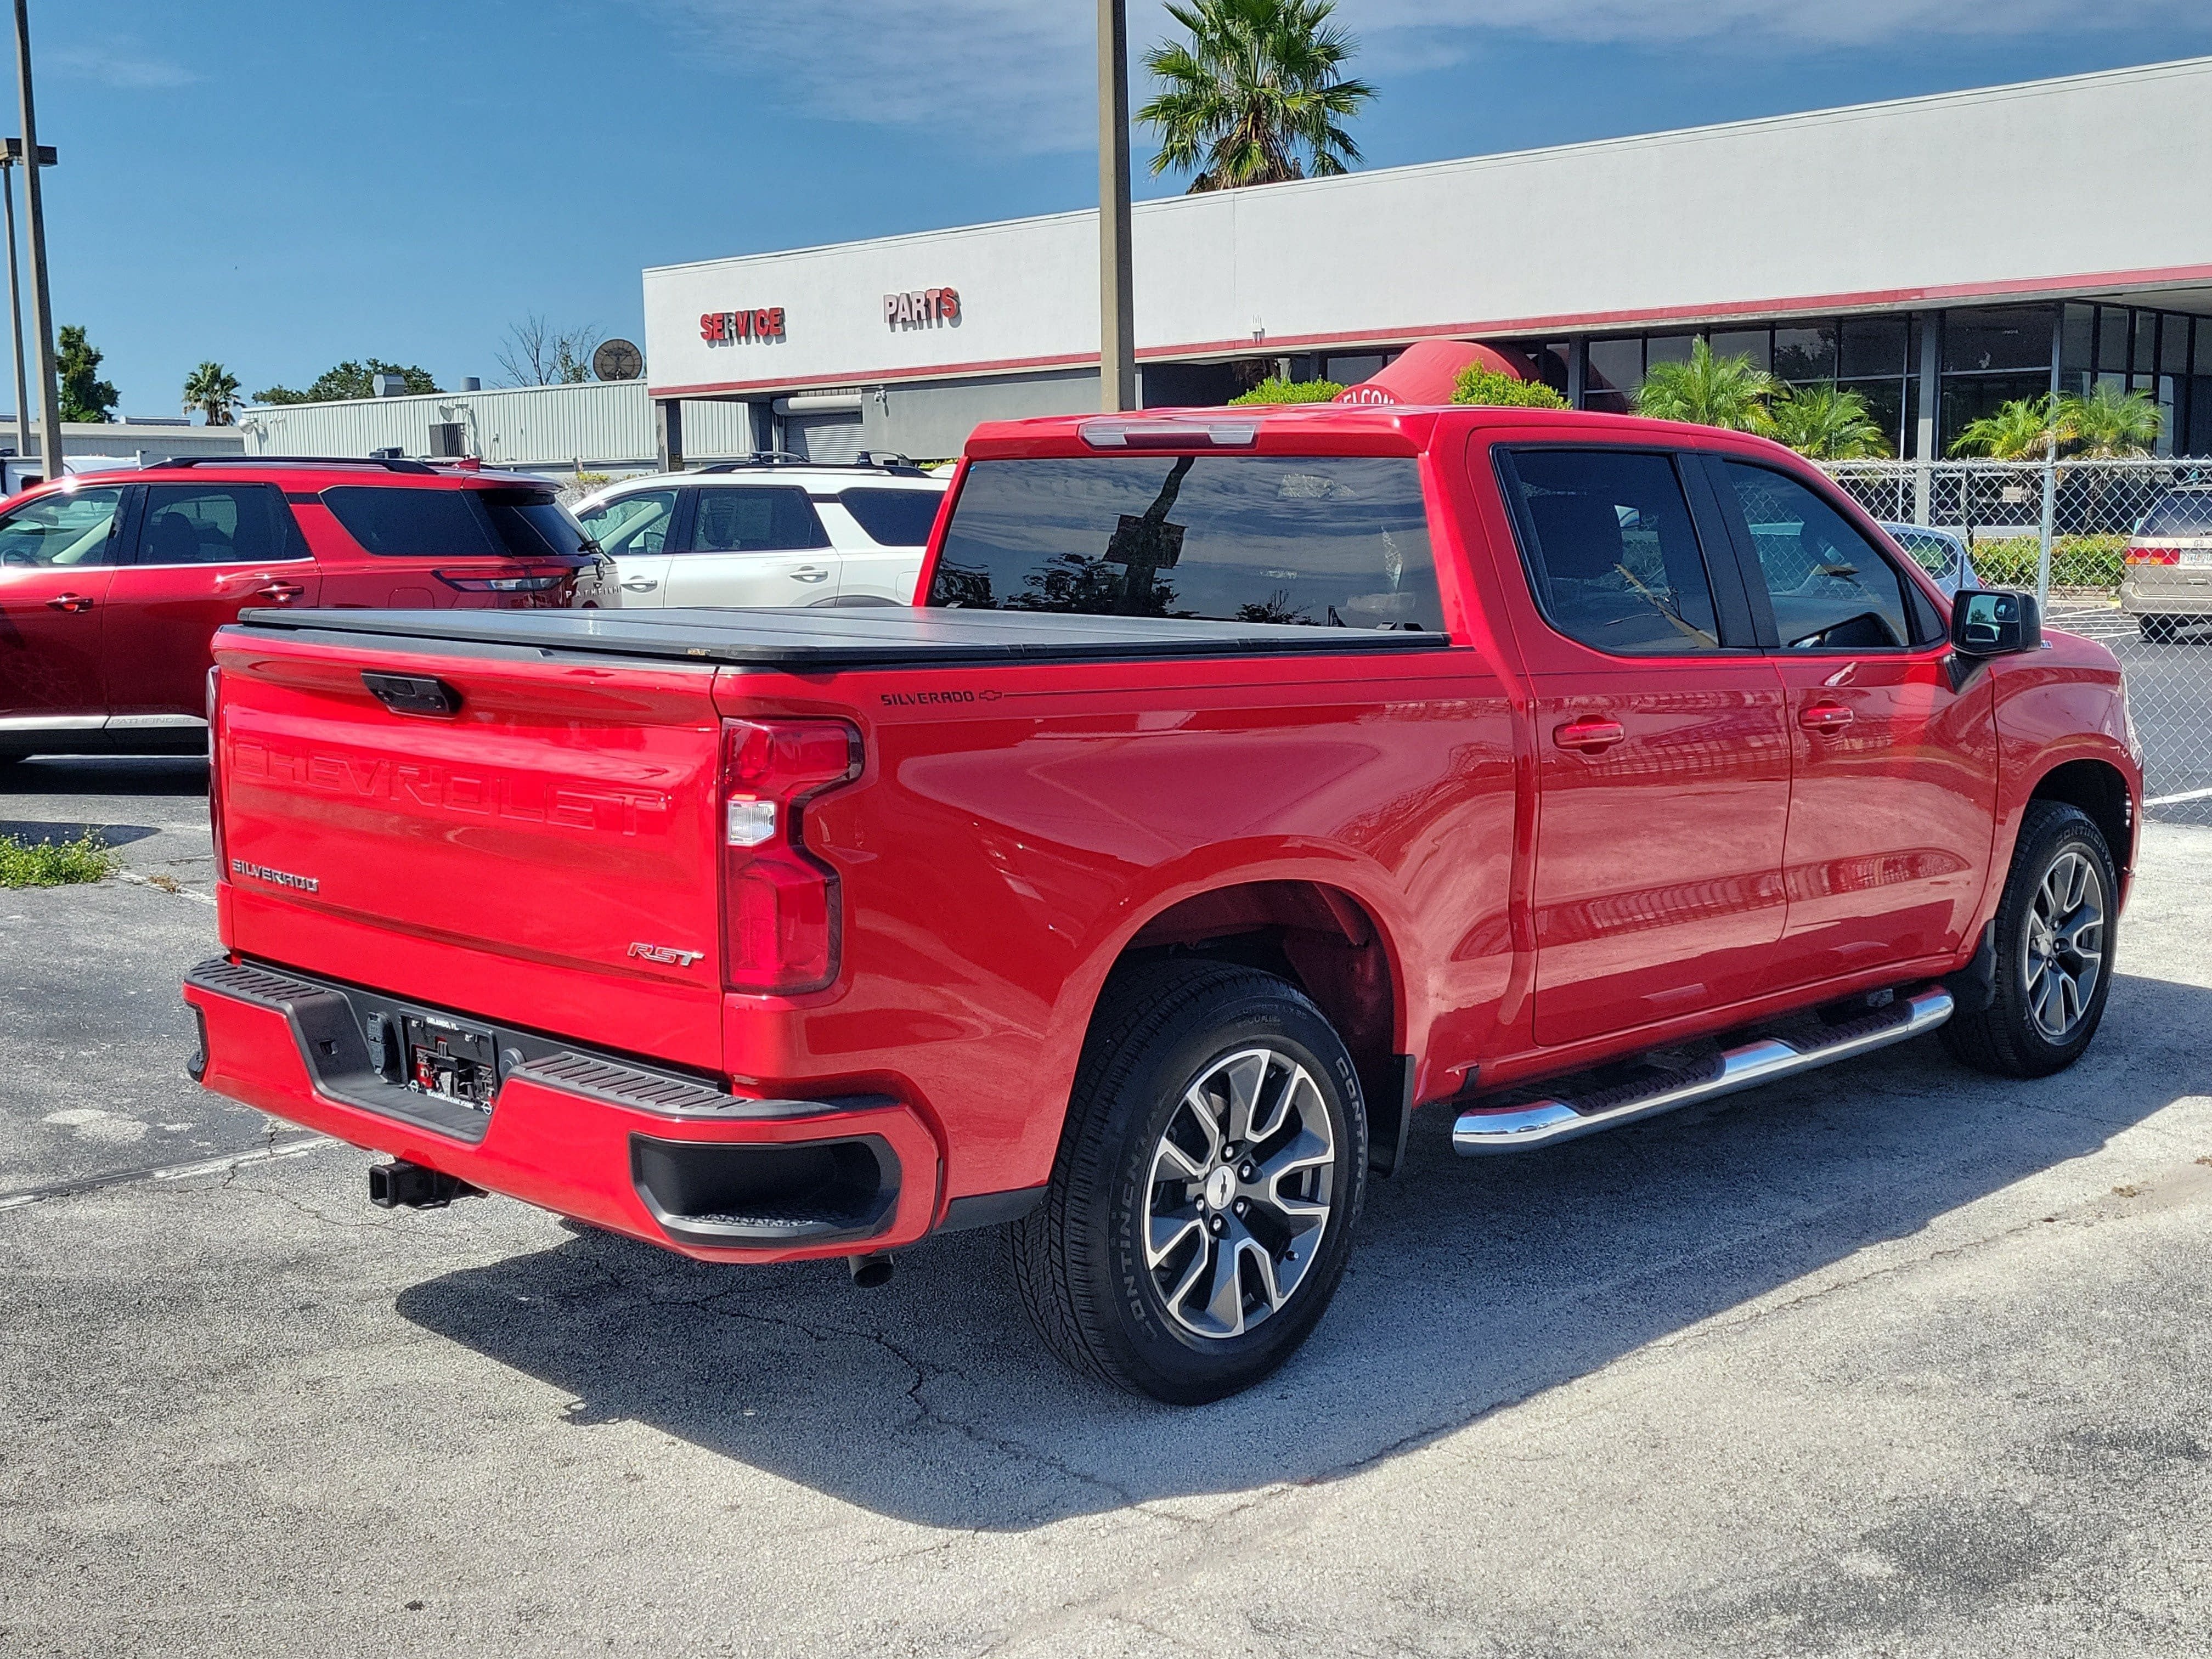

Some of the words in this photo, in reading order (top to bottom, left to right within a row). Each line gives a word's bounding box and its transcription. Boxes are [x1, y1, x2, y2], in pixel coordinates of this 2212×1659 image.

[884, 286, 959, 324] PARTS
[700, 307, 784, 341] SERVICE
[881, 690, 975, 707] SILVERADO
[234, 738, 666, 837] CHEVROLET
[232, 858, 319, 893] SILVERADO
[627, 941, 705, 966] RST
